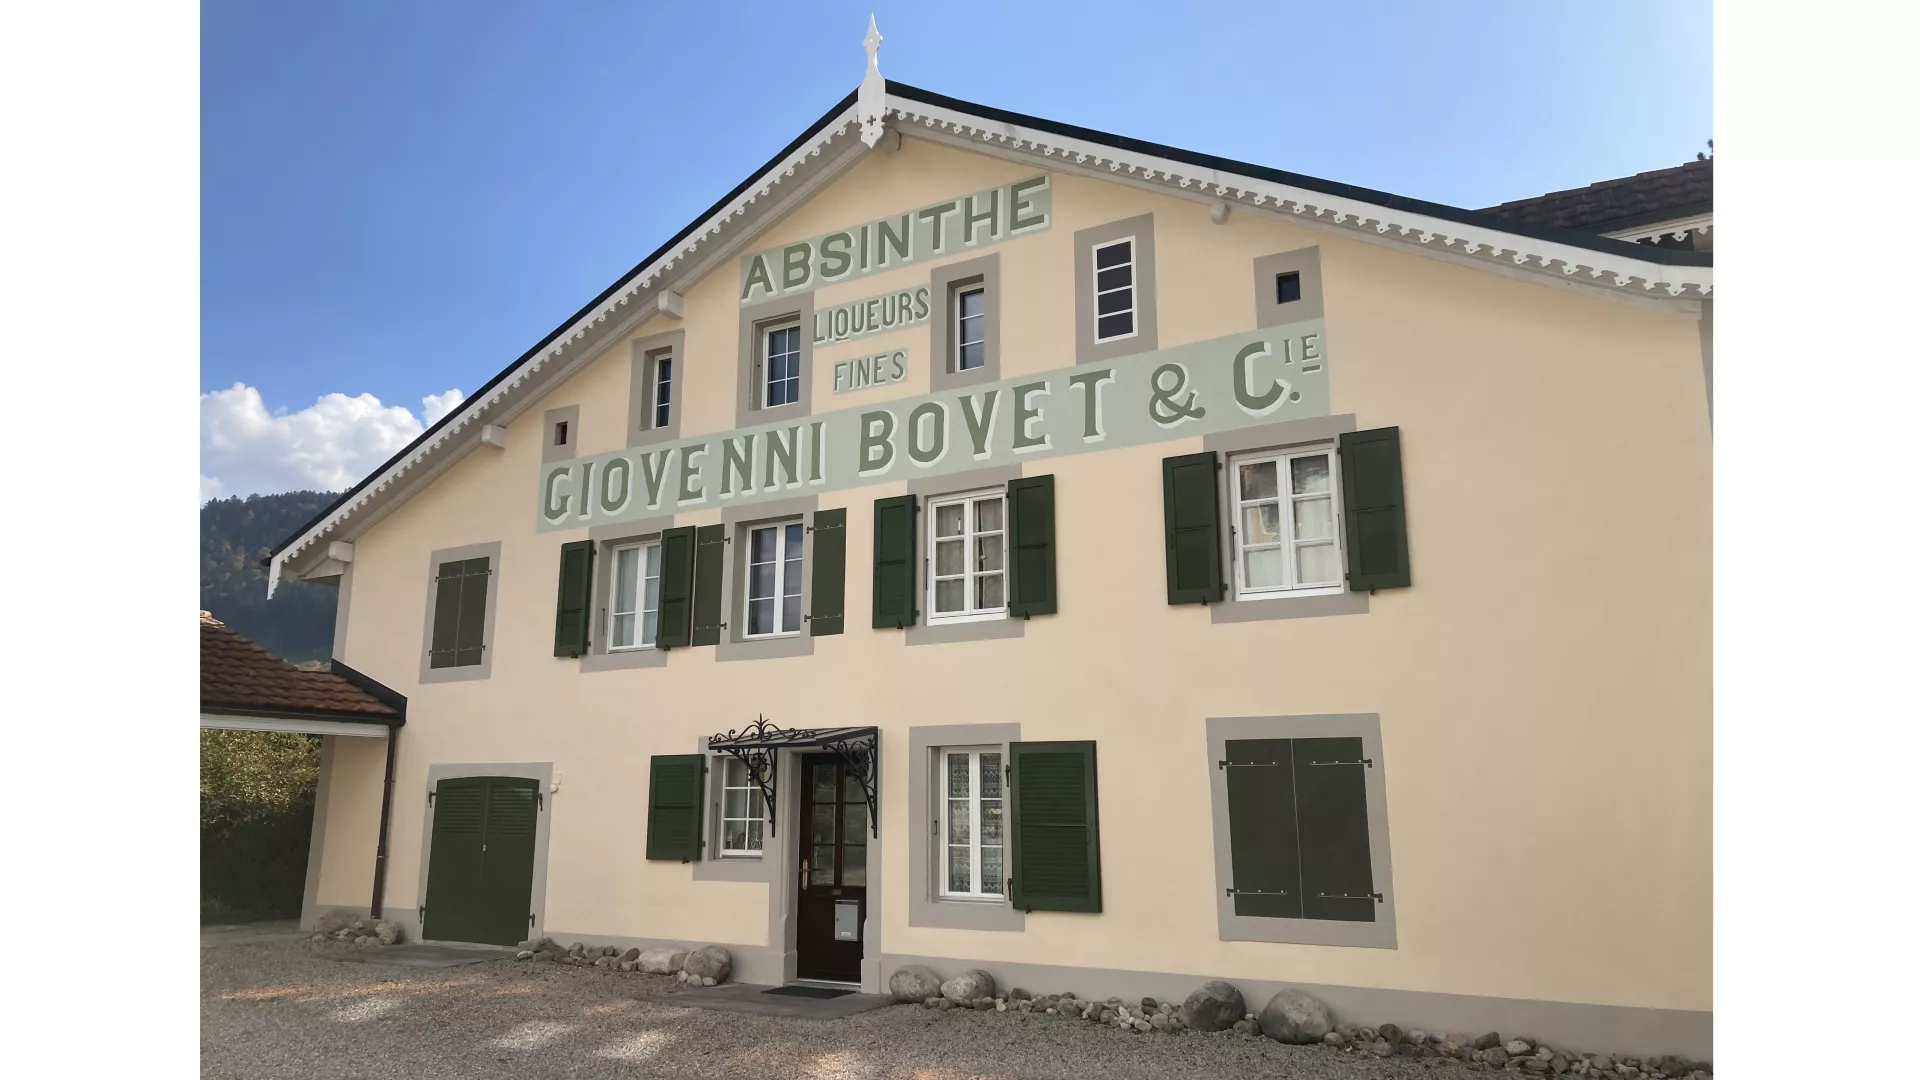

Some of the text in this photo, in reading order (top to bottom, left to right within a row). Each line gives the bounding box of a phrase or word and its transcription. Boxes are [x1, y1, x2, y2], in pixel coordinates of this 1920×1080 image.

[741, 175, 1050, 304] ABSINTHE
[813, 287, 930, 346] LIQUEURS
[834, 350, 906, 392] FINES
[544, 421, 826, 525] GIOVENNI
[858, 369, 1116, 477] BOVET
[1149, 362, 1206, 429] &
